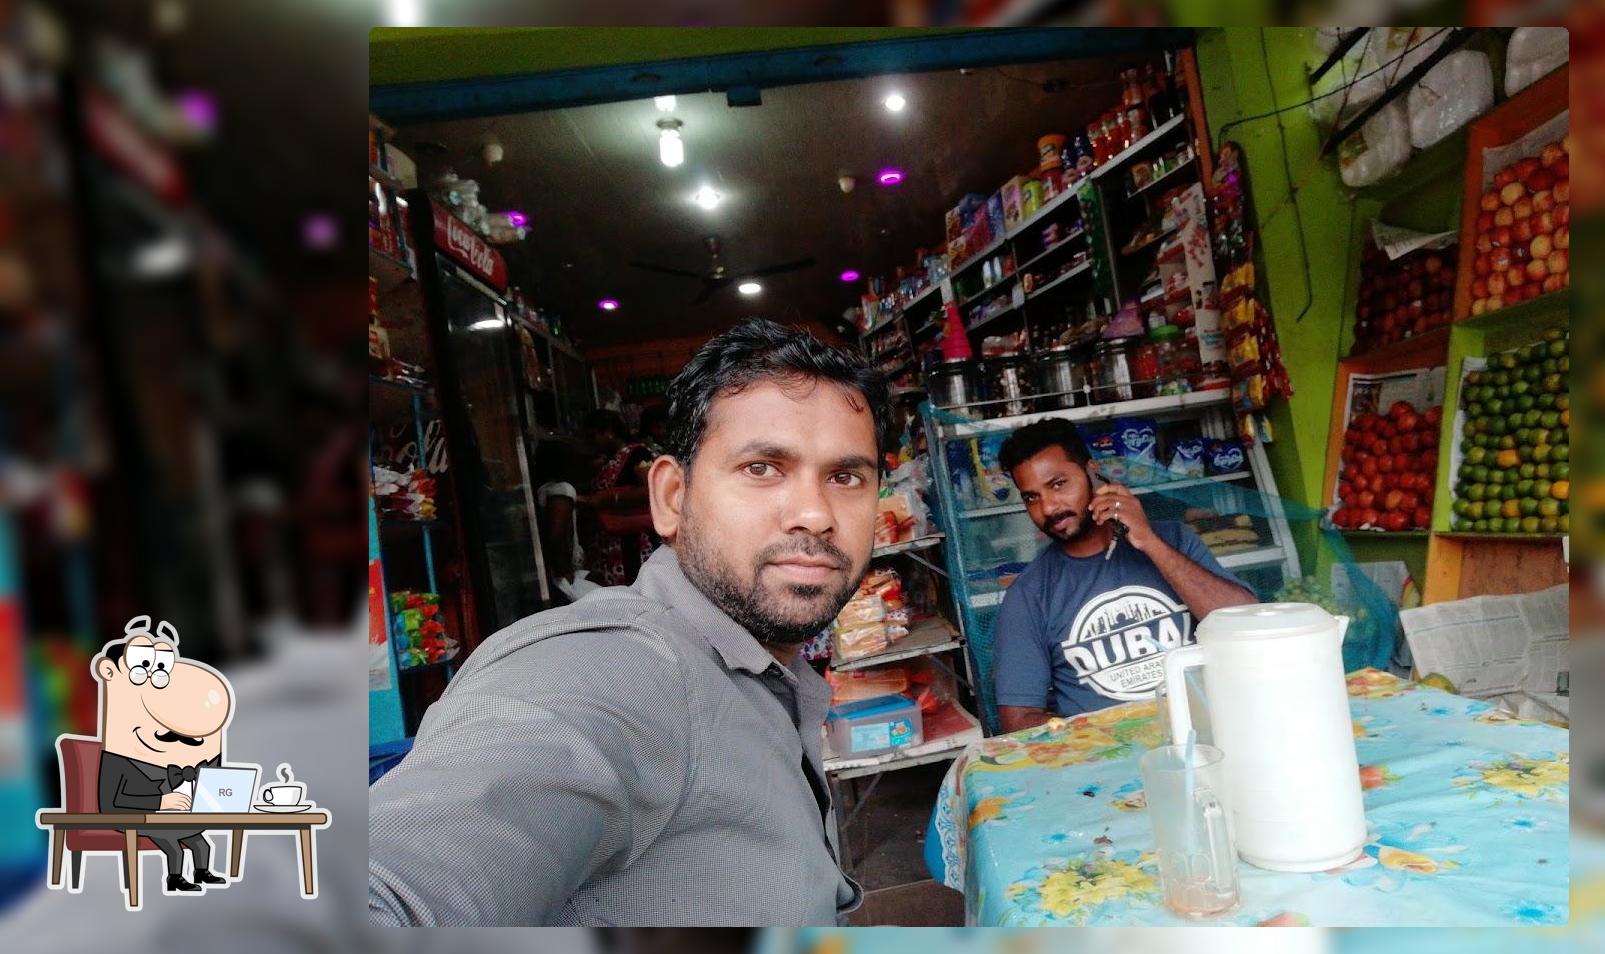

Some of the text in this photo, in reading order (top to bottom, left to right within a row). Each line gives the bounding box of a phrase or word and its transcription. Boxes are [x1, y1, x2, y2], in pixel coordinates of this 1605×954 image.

[1063, 612, 1194, 677] DUBAI
[1110, 660, 1162, 682] UNITED ARA
[1120, 670, 1163, 688] EMIRATES
